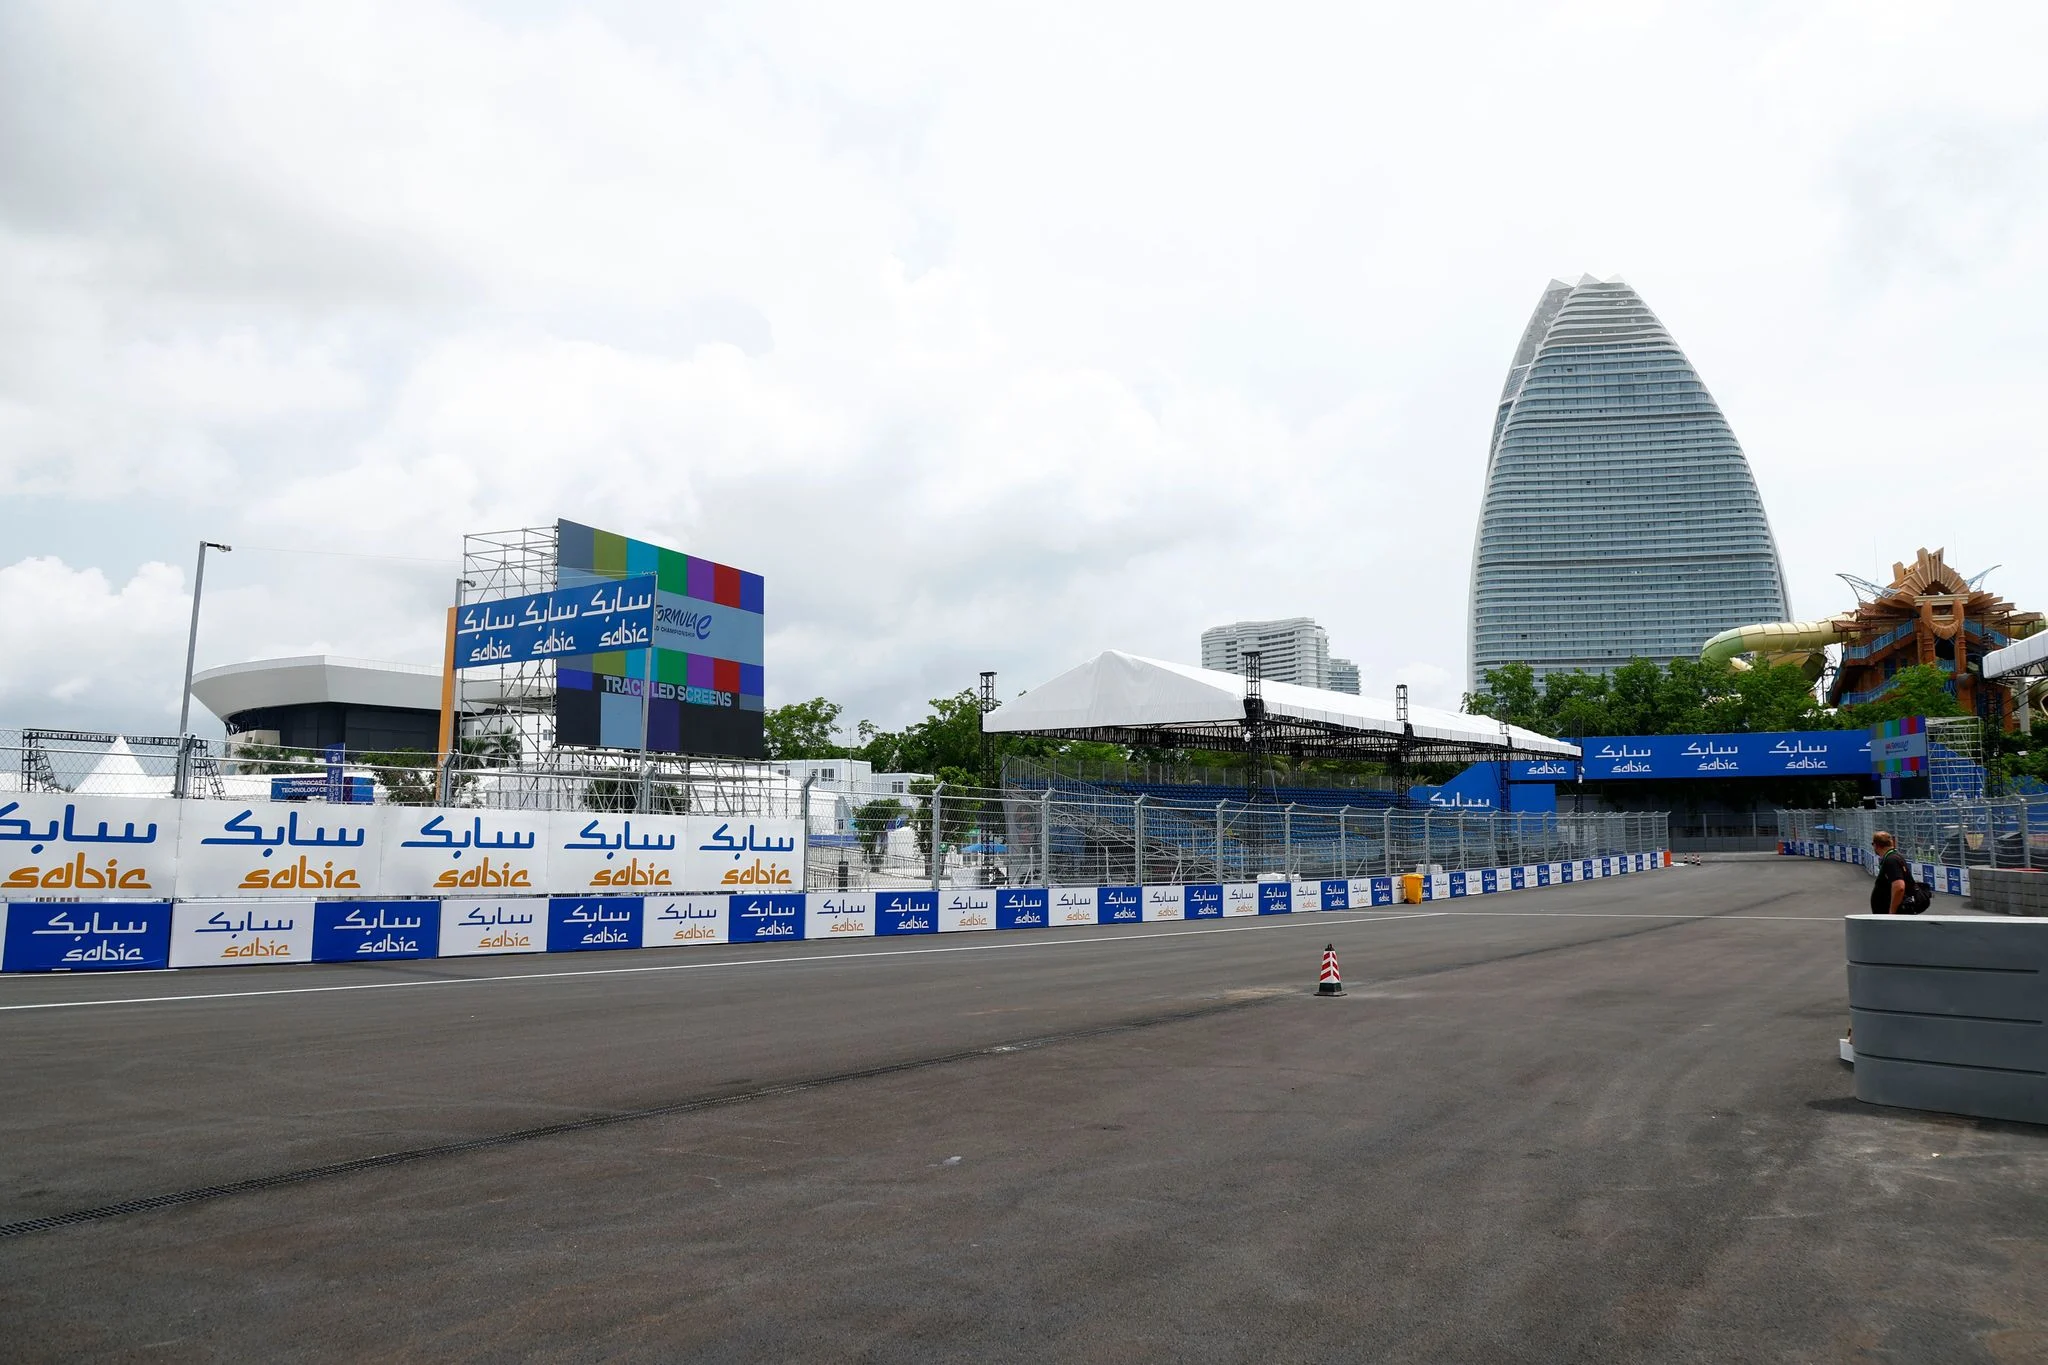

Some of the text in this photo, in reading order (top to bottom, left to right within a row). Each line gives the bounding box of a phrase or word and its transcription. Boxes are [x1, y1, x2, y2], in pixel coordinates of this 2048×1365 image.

[582, 587, 651, 622] سابك
[456, 608, 514, 639] سابك
[518, 598, 578, 631] سابك
[532, 628, 576, 654] sabic
[599, 619, 648, 646] sabic
[470, 637, 511, 661] sabic
[651, 681, 676, 700] LED
[677, 685, 732, 707] SCREENS
[1527, 762, 1567, 775] sabic
[1612, 758, 1651, 772] sabic
[1698, 756, 1738, 770] sabic
[1786, 754, 1827, 768] sabic
[201, 810, 364, 857] سابك
[401, 816, 534, 859] سابك
[564, 820, 674, 860] سابك
[700, 824, 794, 860] سابك
[0, 852, 151, 889] sabic
[238, 856, 360, 888] sabic
[433, 857, 531, 888] sabic
[590, 858, 672, 886] sabic
[721, 859, 792, 884] sabic
[886, 898, 929, 916] سابك
[948, 896, 988, 914] سابك
[1005, 895, 1041, 912] سابك
[1057, 894, 1090, 909] سابك
[1105, 892, 1136, 907] سابك
[1150, 892, 1178, 906] سابك
[564, 905, 630, 928] سابك
[658, 903, 716, 924] سابك
[741, 901, 794, 921] سابك
[817, 900, 865, 918] سابك
[1014, 911, 1041, 923] sabic
[1066, 909, 1090, 921] sabic
[1114, 907, 1136, 918] sabic
[1157, 906, 1178, 916] sabic
[32, 912, 146, 941] سابك
[195, 912, 293, 938] سابك
[334, 910, 420, 935] سابك
[458, 907, 532, 931] سابك
[756, 920, 794, 936] sabic
[831, 916, 864, 932] sabic
[898, 913, 929, 929] sabic
[958, 913, 987, 927] sabic
[478, 930, 530, 947] sabic
[581, 926, 628, 943] sabic
[674, 924, 714, 939] sabic
[62, 940, 144, 961] sabic
[221, 938, 290, 957] sabic
[357, 934, 418, 953] sabic
